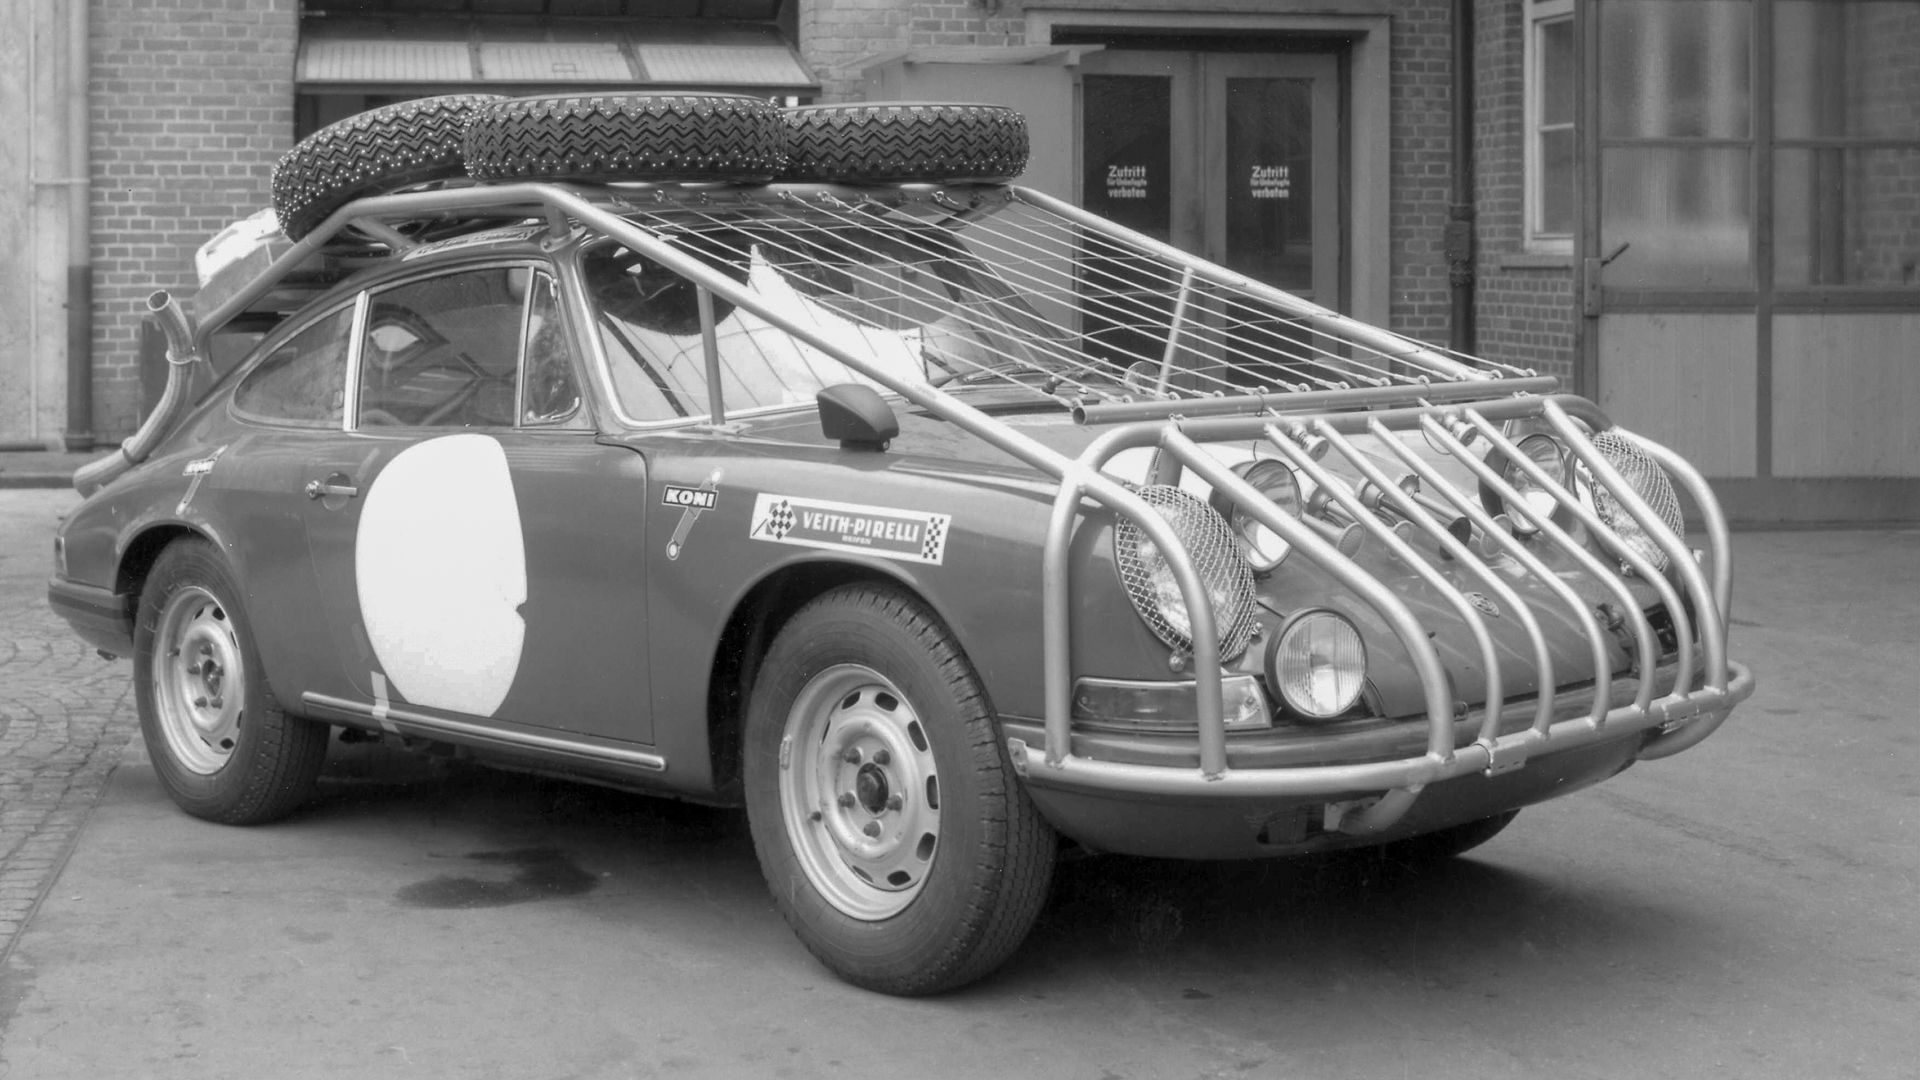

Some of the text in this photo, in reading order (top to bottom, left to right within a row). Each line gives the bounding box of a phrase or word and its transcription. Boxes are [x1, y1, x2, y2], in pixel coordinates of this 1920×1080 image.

[1108, 165, 1146, 177] Zutritt
[1252, 165, 1289, 178] Zutritt
[1108, 186, 1146, 198] verboten
[1251, 186, 1289, 198] verboten
[666, 488, 715, 507] KONI
[803, 511, 920, 543] VEITH-PIRELLI
